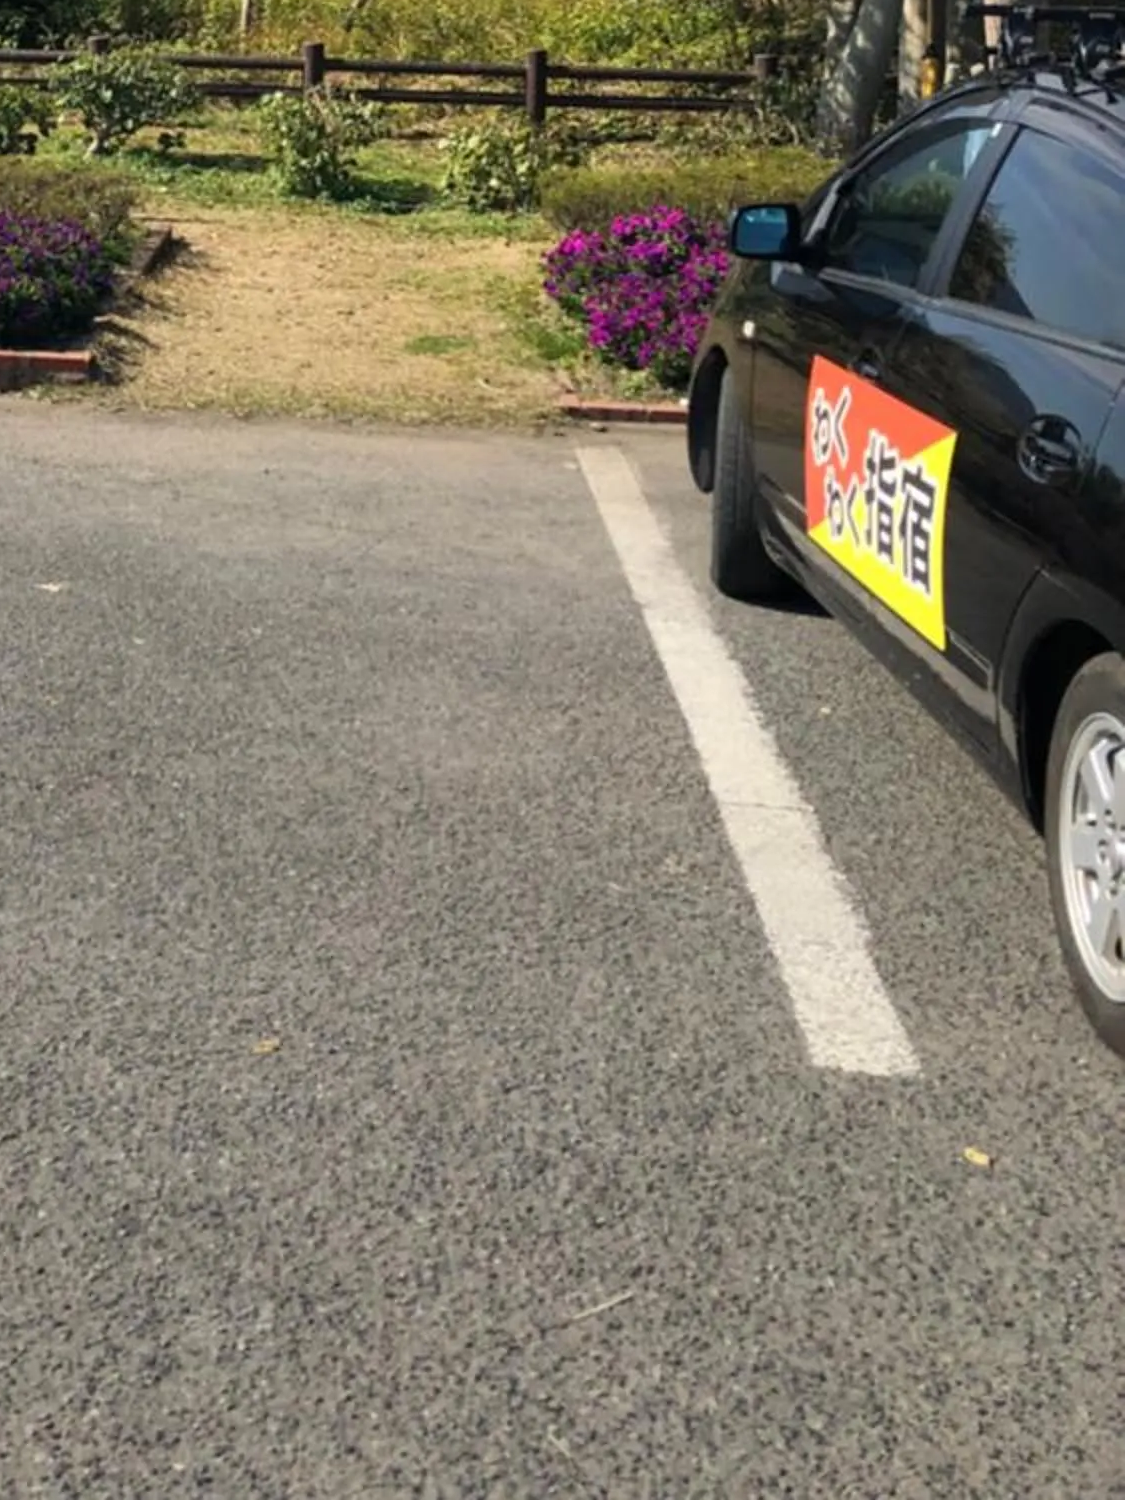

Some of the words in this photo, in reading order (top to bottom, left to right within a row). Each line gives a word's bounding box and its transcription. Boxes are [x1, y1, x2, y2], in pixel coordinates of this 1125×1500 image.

[813, 388, 850, 466] わく
[824, 470, 861, 548] わく
[862, 427, 937, 596] 指宿
